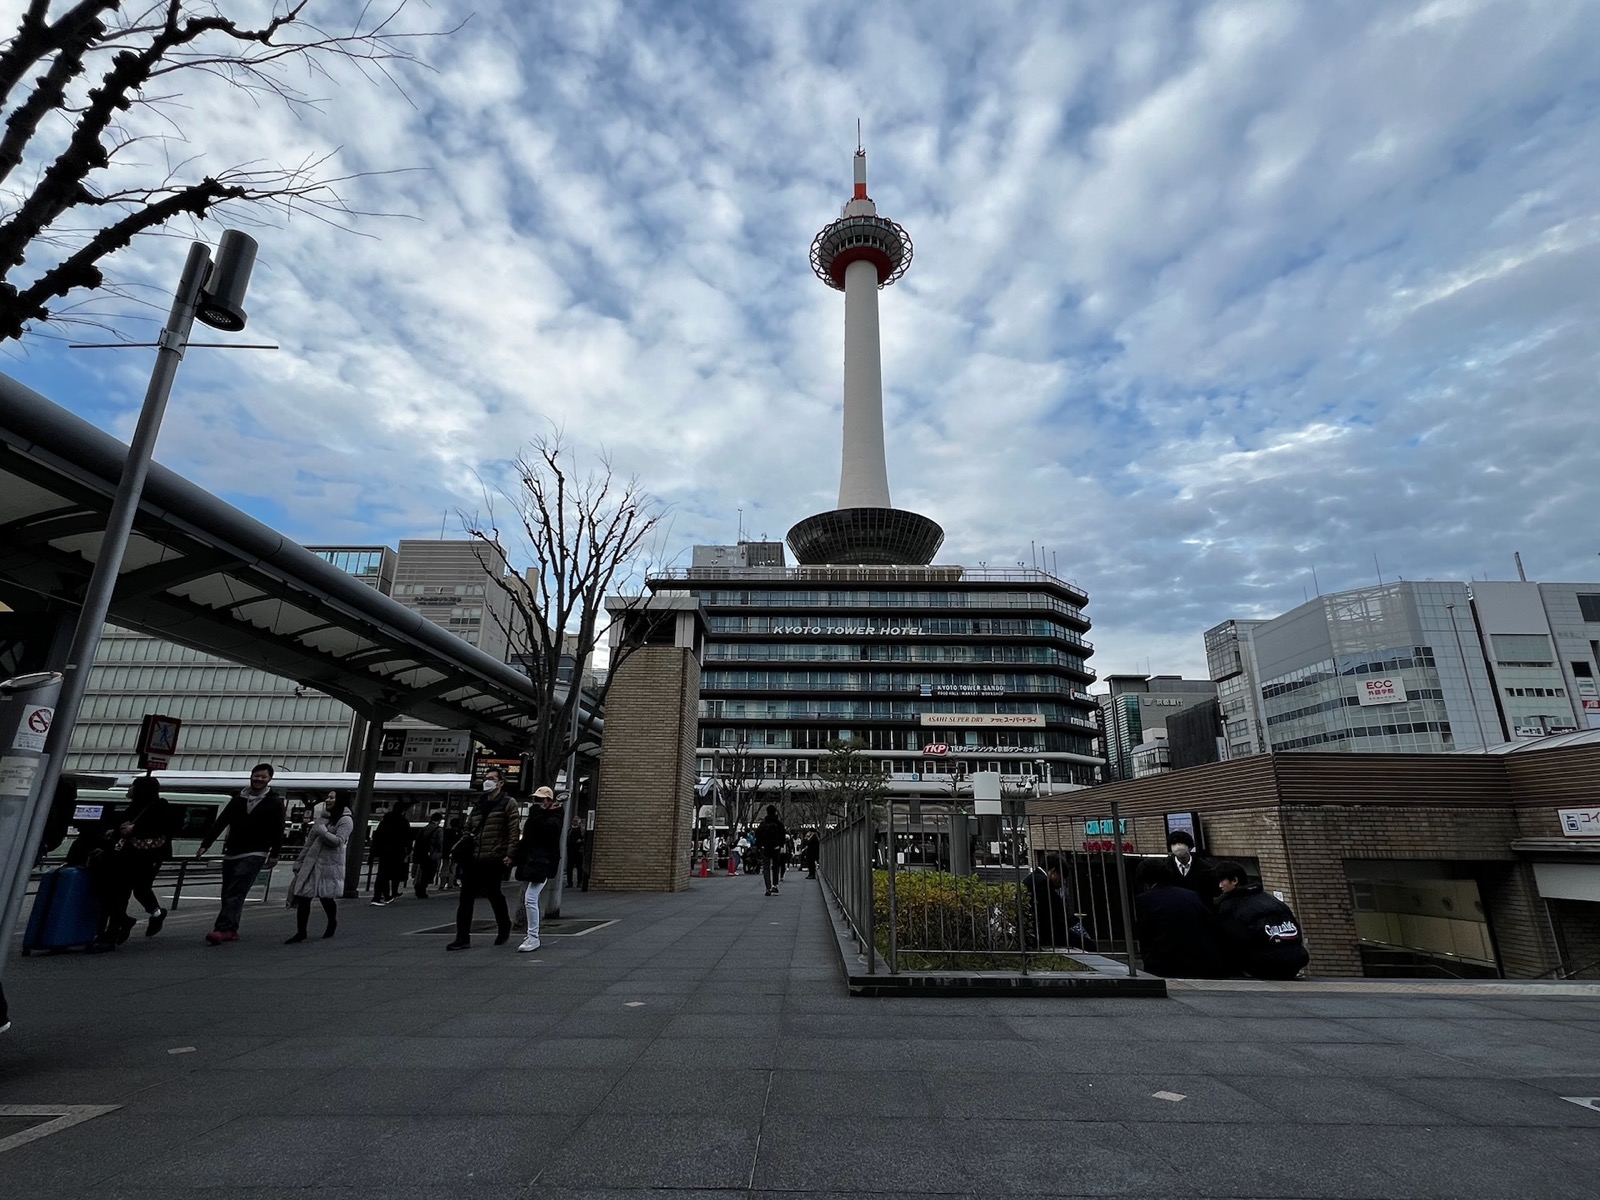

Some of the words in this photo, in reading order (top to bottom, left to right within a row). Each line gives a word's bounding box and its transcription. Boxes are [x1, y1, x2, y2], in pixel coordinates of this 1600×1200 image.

[773, 626, 821, 635] KYOTO
[826, 626, 876, 635] TOWER
[879, 627, 926, 635] HOTEL
[1366, 679, 1393, 690] ECC
[387, 741, 401, 751] D2
[925, 744, 945, 753] TKP
